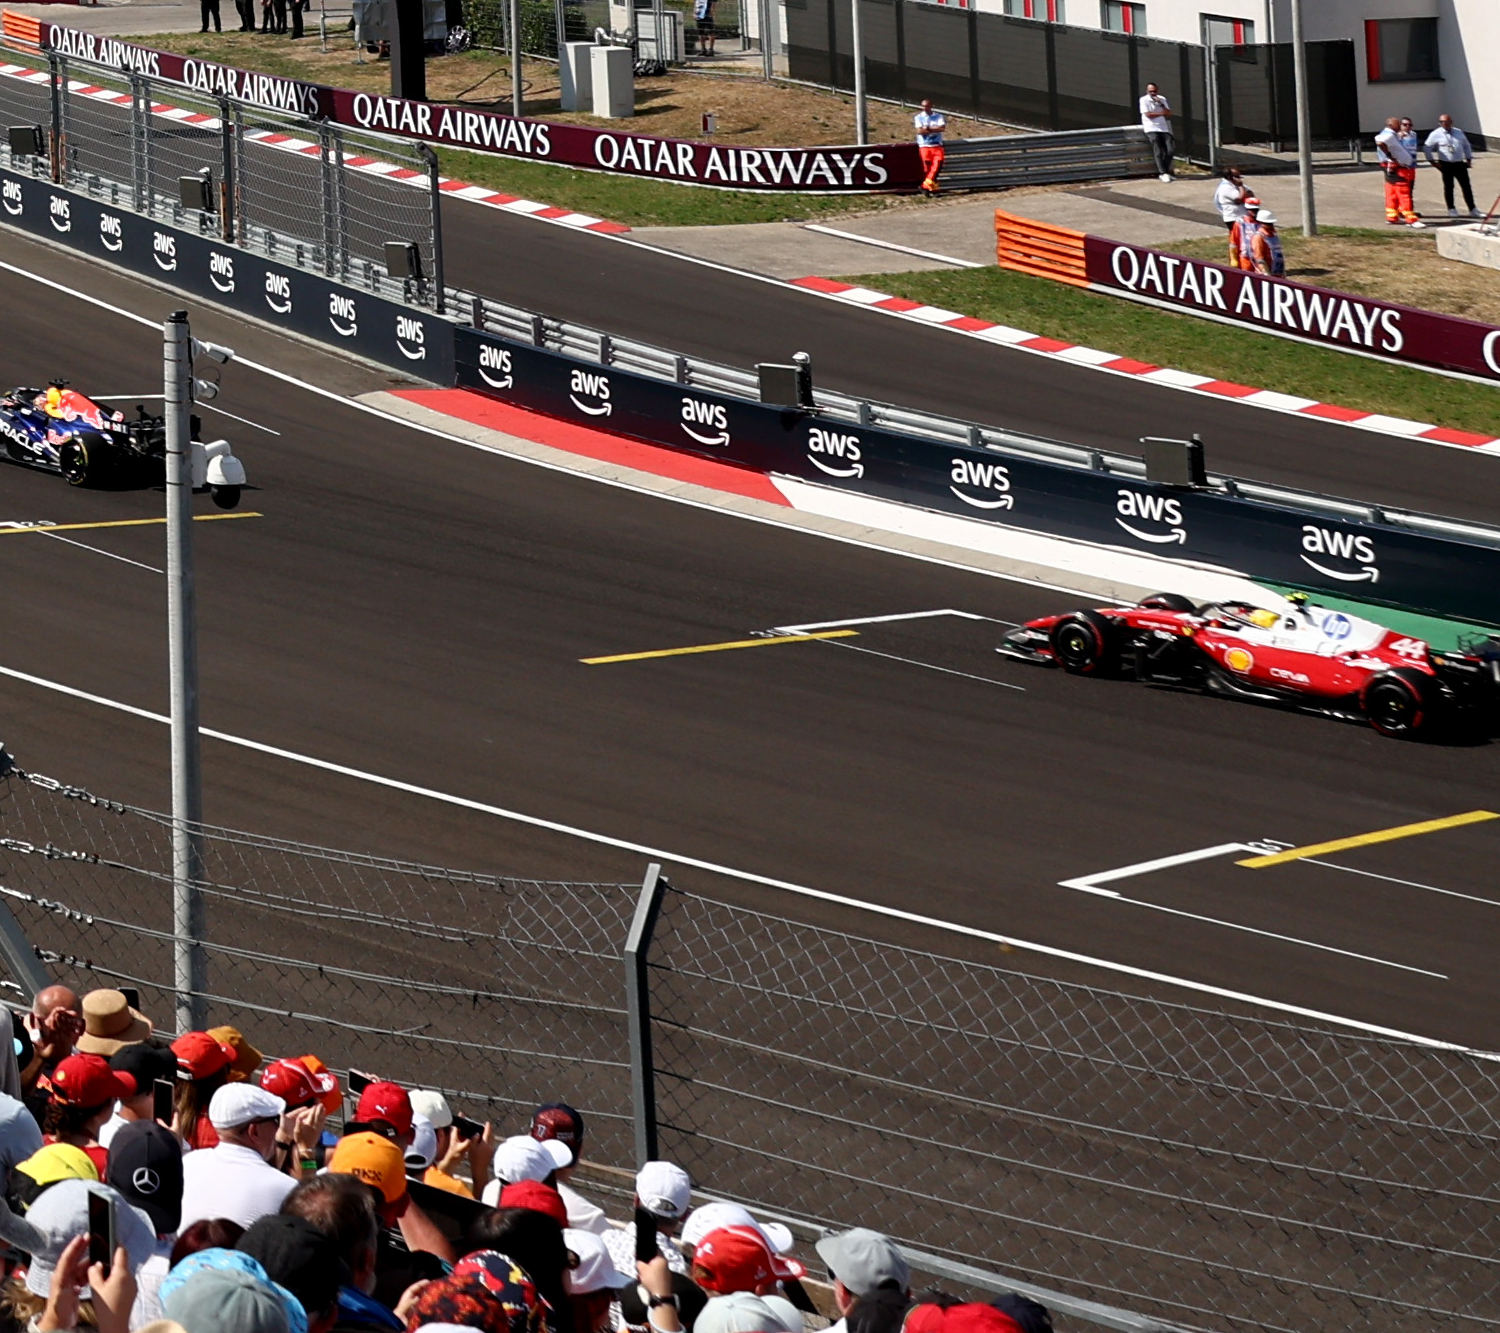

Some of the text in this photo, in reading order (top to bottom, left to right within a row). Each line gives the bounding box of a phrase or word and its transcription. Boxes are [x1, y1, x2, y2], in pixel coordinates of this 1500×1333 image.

[49, 24, 160, 78] QATAR AIRWAYS
[183, 59, 319, 116] QATAR AIRWAYS
[353, 93, 551, 158] QATAR AIRWAYS
[594, 133, 889, 186] QATAR AIRWAYS
[3, 179, 22, 201] aws
[50, 196, 70, 218] aws
[101, 213, 121, 237] aws
[154, 232, 176, 256] aws
[211, 252, 234, 277] aws
[266, 271, 290, 298] aws
[330, 294, 356, 320] aws
[397, 316, 424, 343] aws
[1111, 245, 1228, 311] QATAR
[1235, 275, 1405, 353] AIRWAYS
[480, 345, 1375, 563] aws aws aws aws aws aws aws
[1323, 617, 1352, 640] hp
[1389, 638, 1427, 659] 44
[1269, 666, 1311, 684] CEVA
